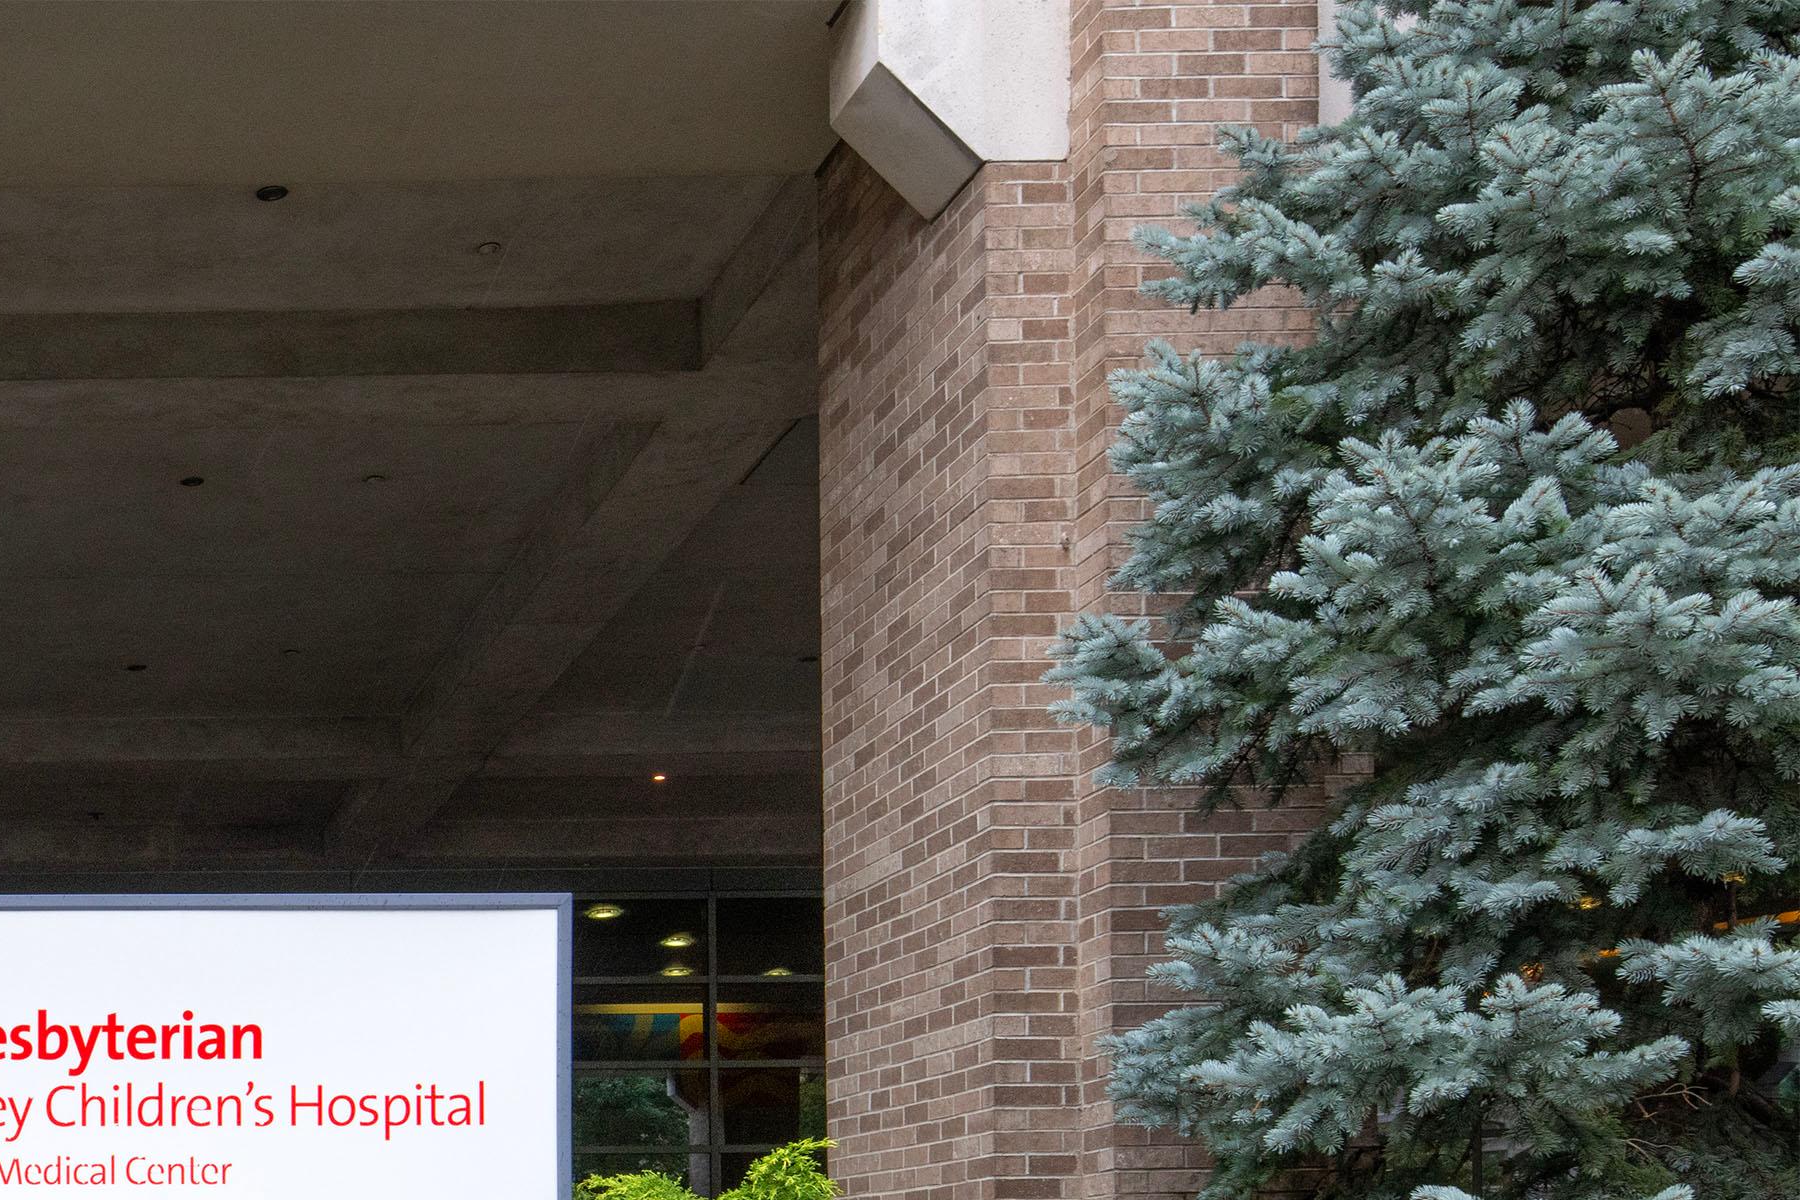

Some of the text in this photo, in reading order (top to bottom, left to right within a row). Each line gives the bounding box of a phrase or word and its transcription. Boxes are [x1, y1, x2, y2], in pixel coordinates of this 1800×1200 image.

[46, 1080, 275, 1128] Children’s
[291, 1080, 486, 1142] Hospital
[125, 1156, 233, 1186] Center
